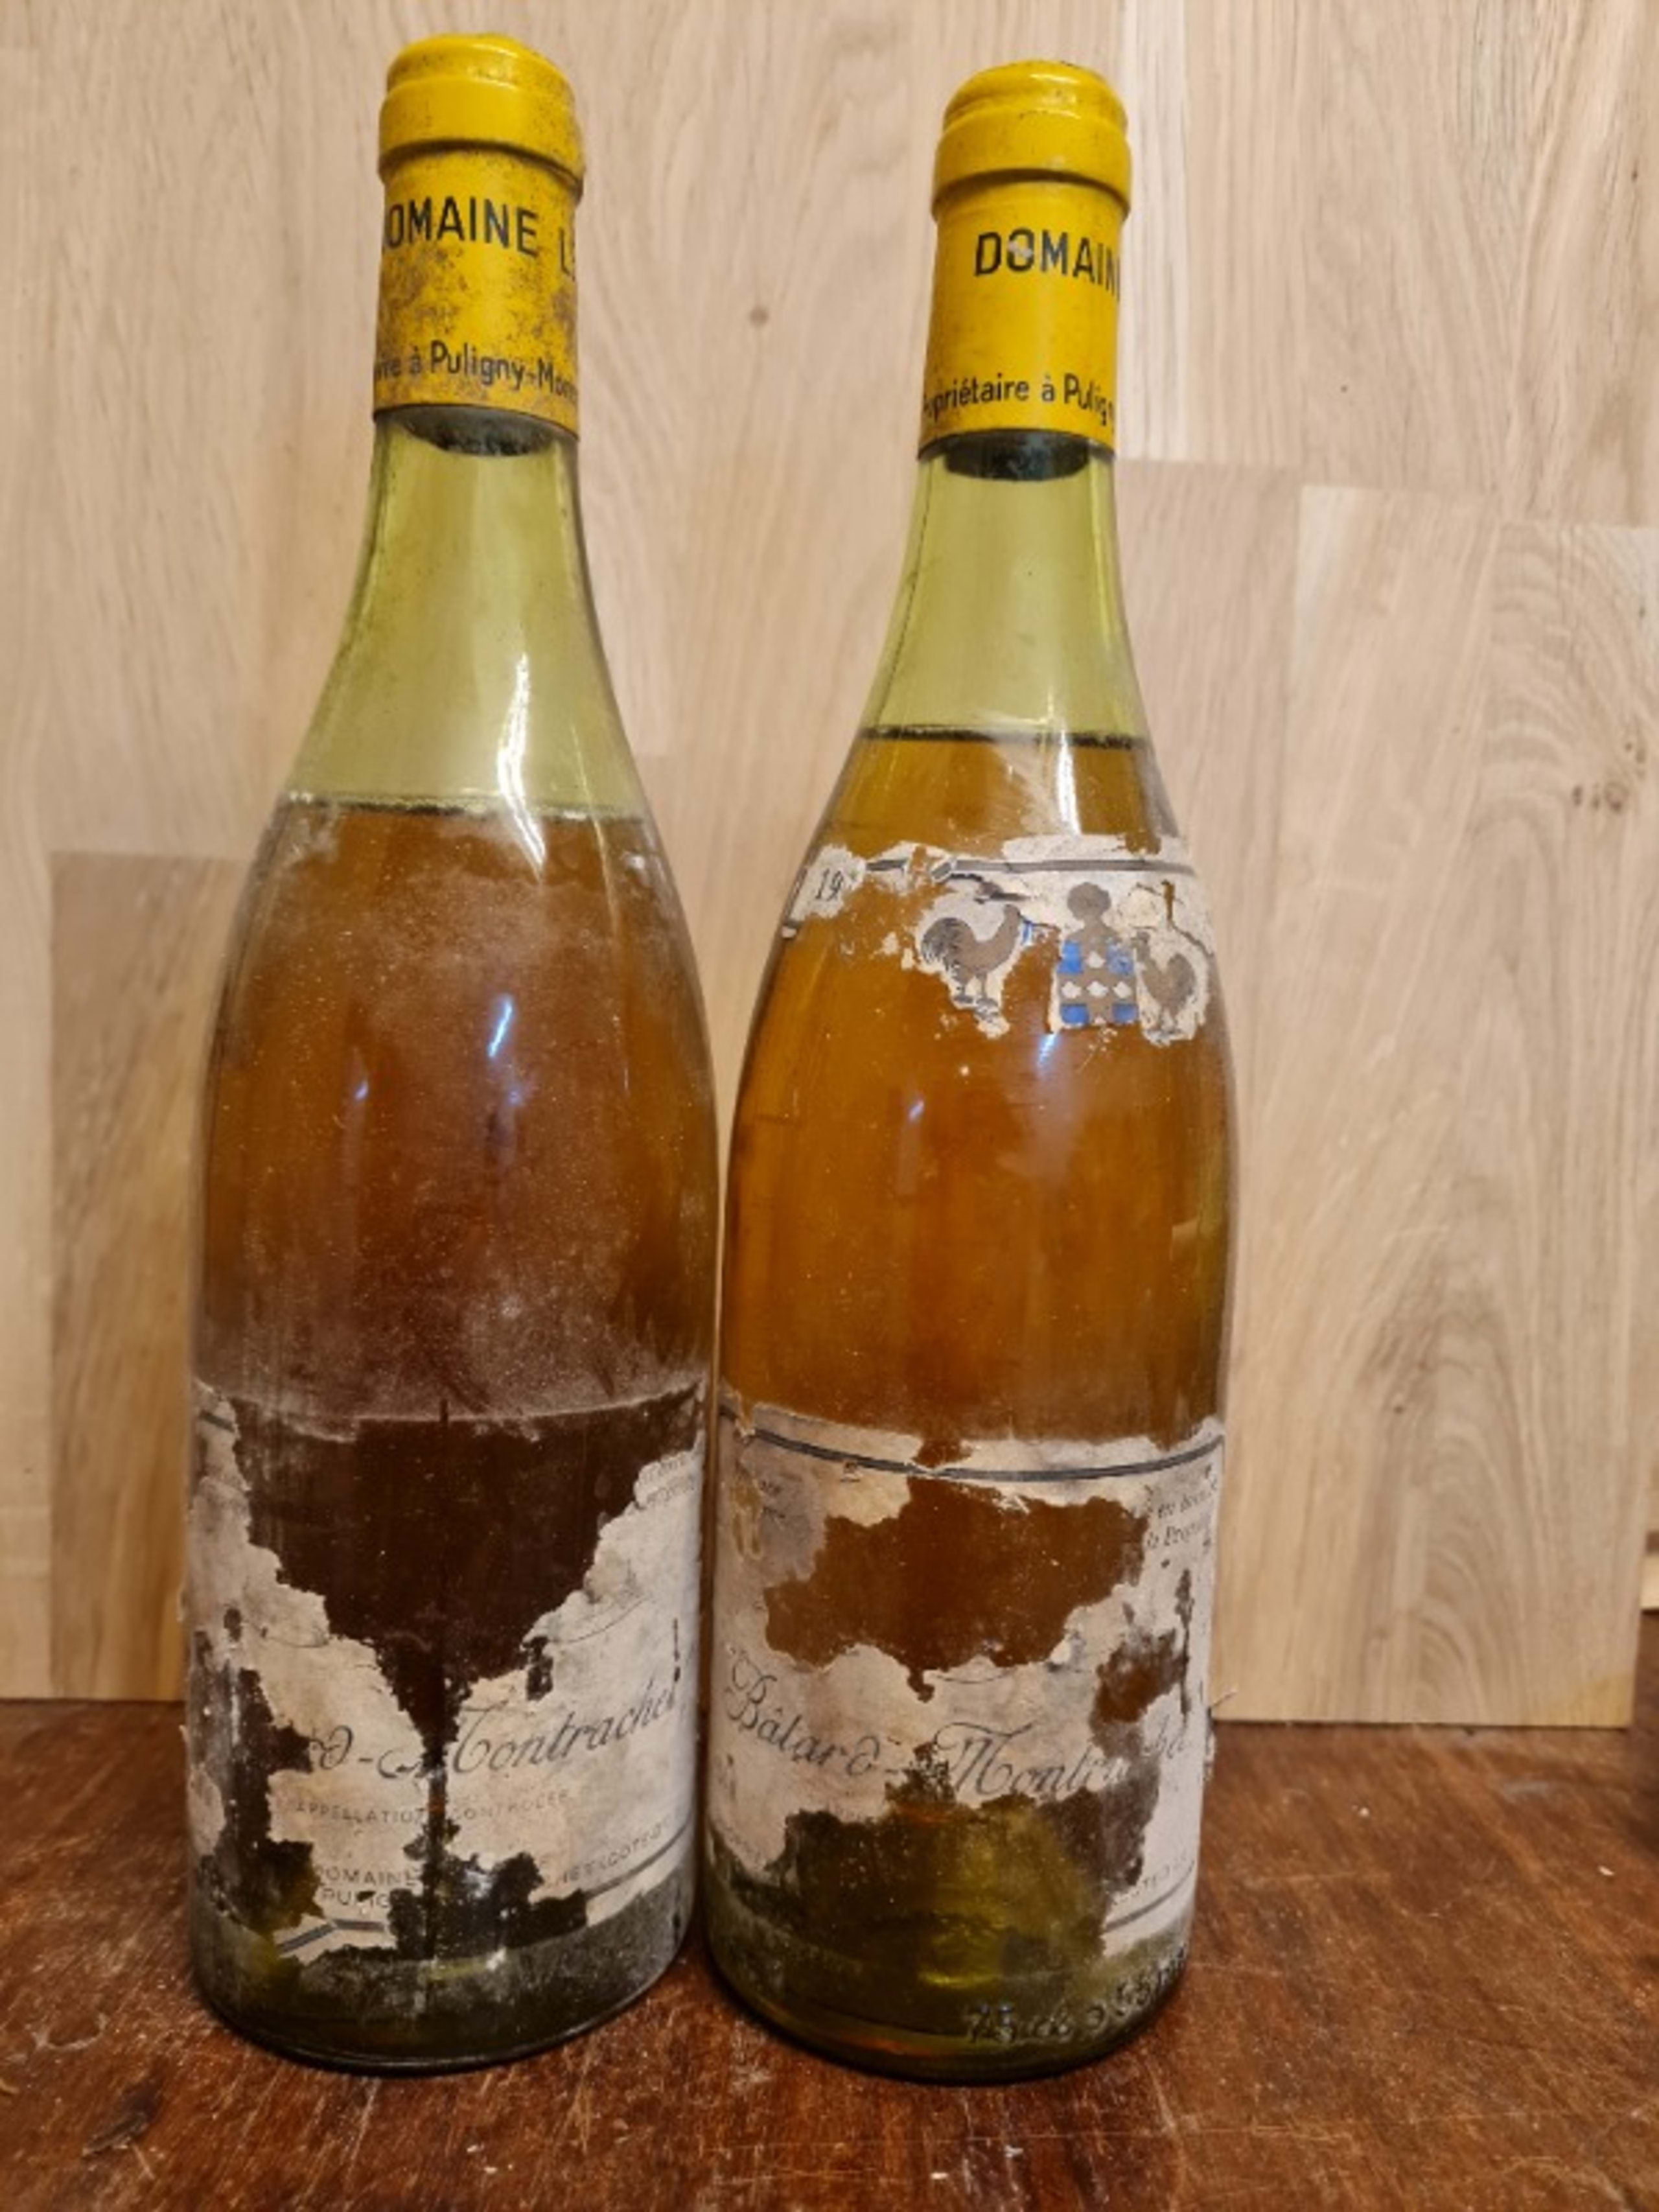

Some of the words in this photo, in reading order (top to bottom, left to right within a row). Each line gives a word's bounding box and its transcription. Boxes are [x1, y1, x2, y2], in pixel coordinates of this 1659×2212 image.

[388, 196, 539, 258] OMAINE
[974, 227, 1121, 303] DOMAIN
[1041, 373, 1056, 403] à
[814, 867, 844, 902] 19
